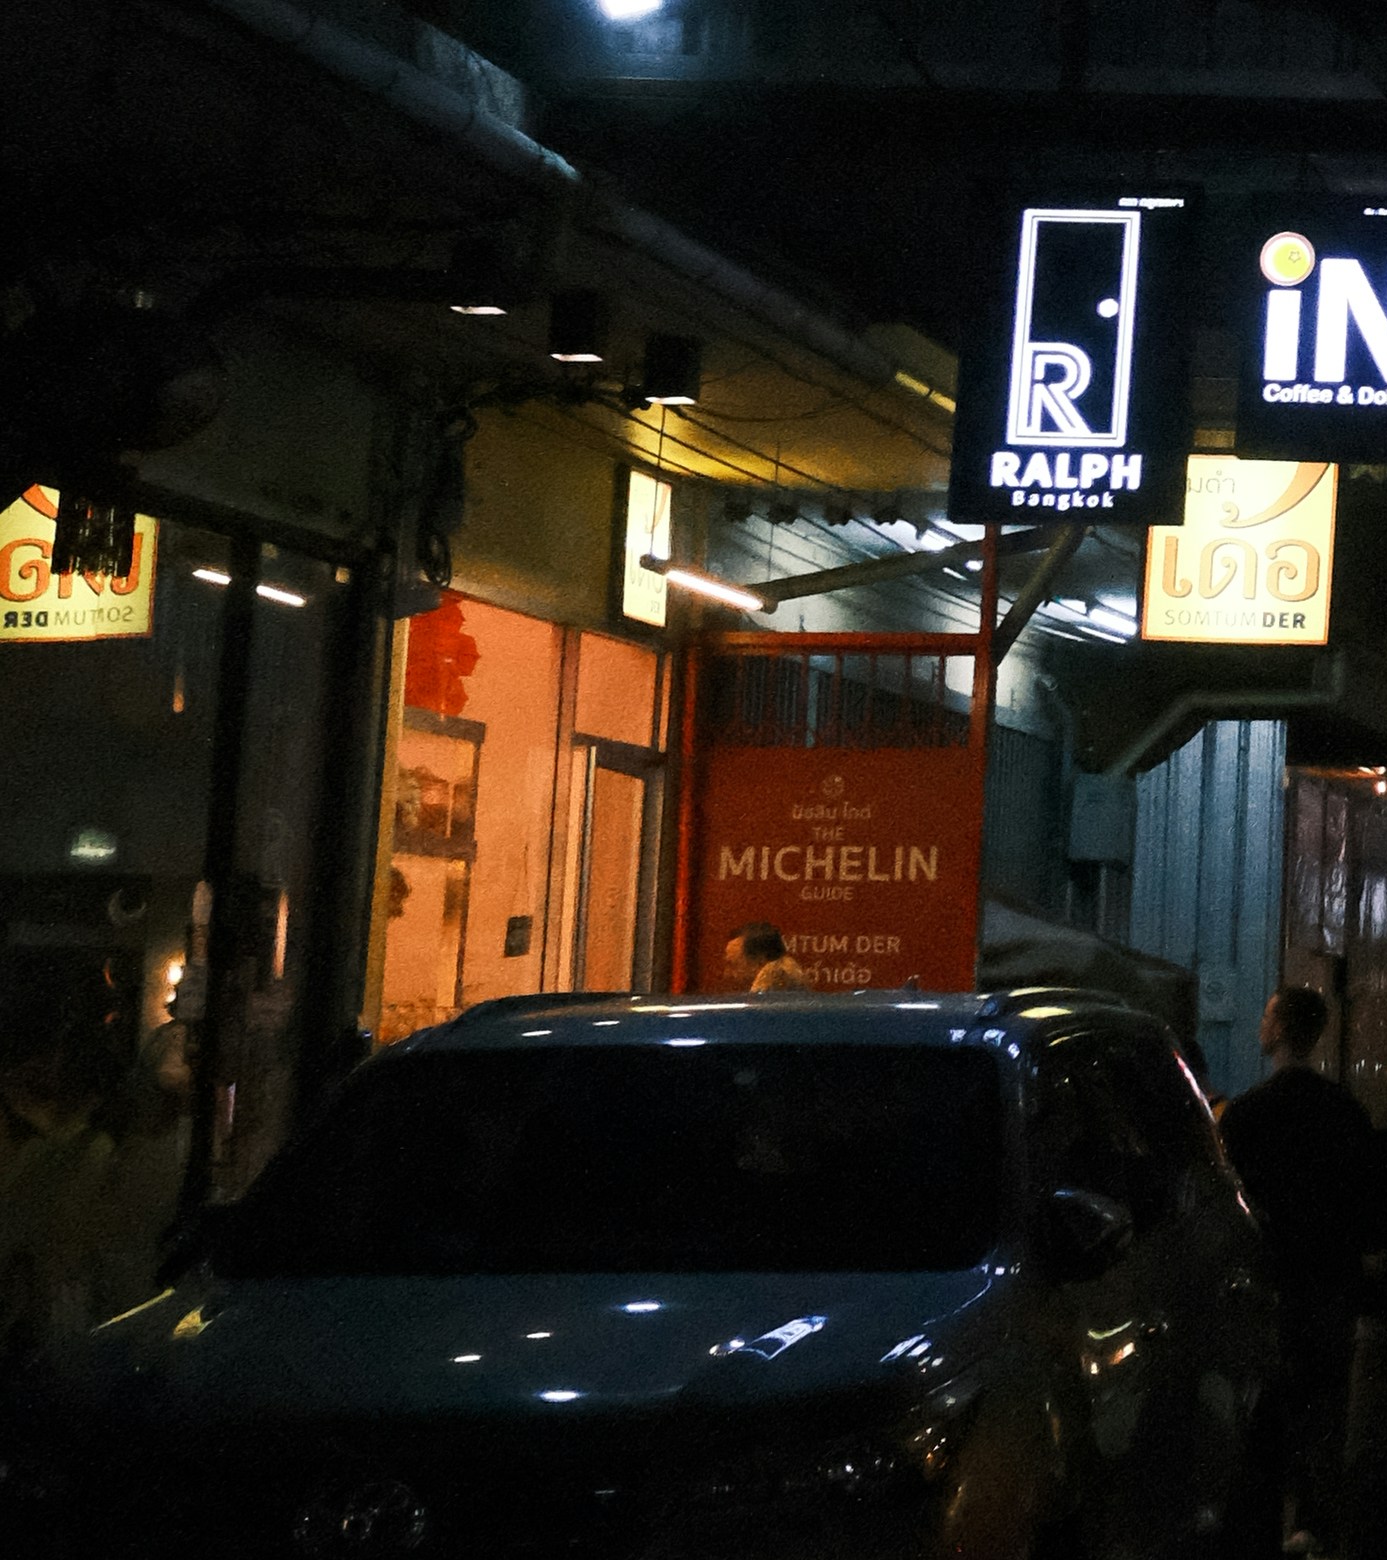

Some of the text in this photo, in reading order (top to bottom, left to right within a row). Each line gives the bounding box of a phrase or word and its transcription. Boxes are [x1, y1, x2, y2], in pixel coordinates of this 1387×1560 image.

[1263, 383, 1333, 405] Coffee
[1336, 385, 1355, 405] &
[990, 451, 1143, 492] RALPH
[1011, 489, 1115, 511] Bangkok
[1164, 609, 1307, 629] SOMTUM DER
[812, 827, 845, 842] THE
[718, 844, 939, 882] MICHELIN
[800, 885, 855, 902] GUIDE
[855, 935, 902, 954] DER
